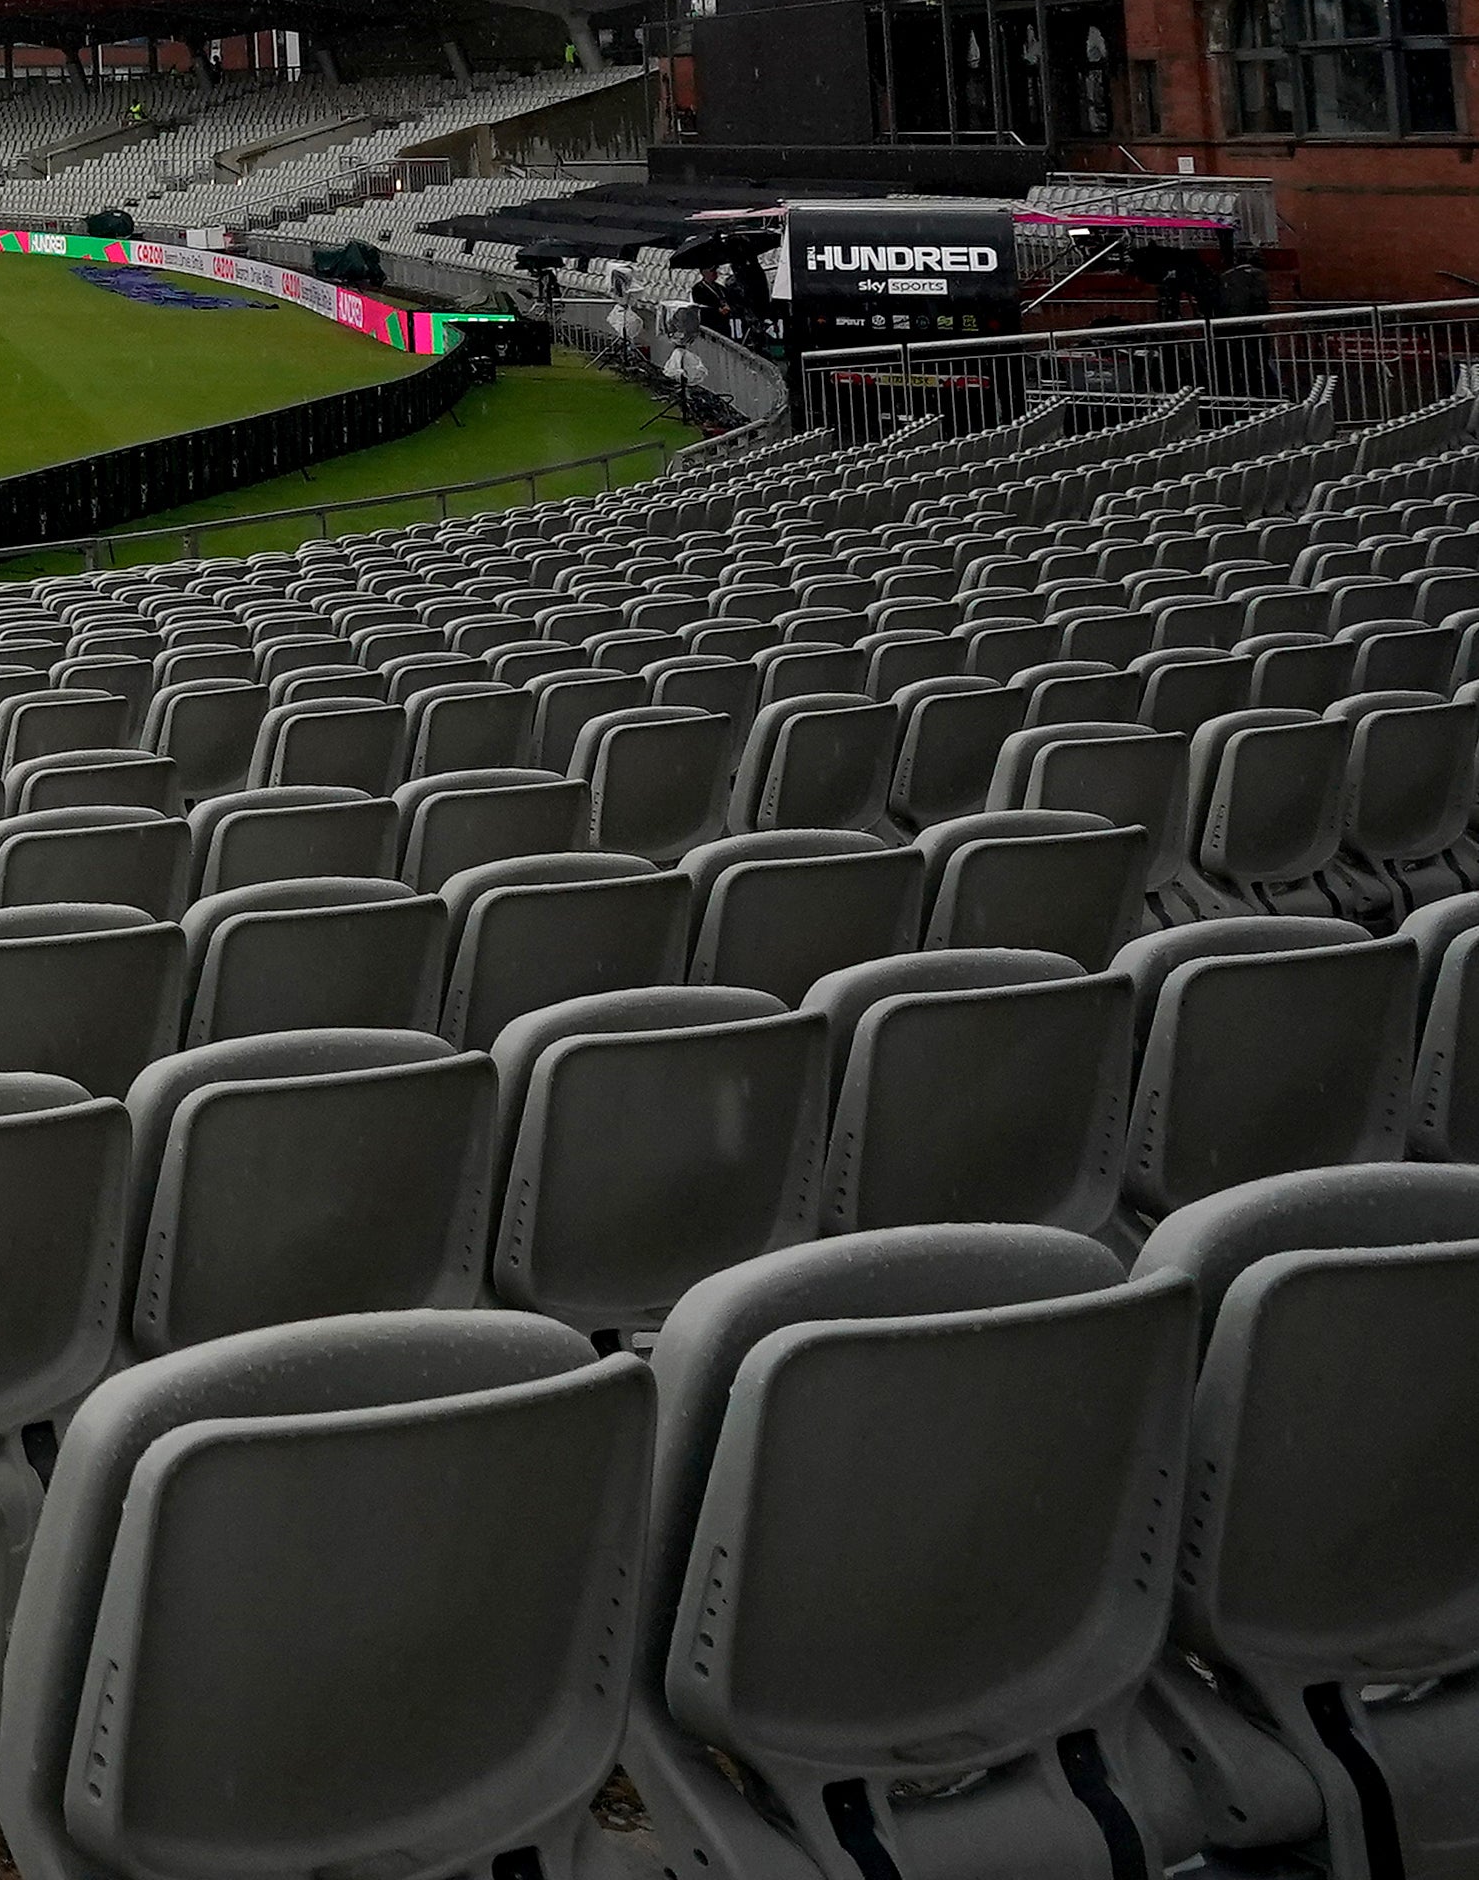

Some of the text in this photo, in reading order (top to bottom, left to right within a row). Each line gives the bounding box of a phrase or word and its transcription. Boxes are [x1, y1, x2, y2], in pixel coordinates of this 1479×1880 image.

[31, 233, 66, 254] HUNDRED
[137, 244, 164, 265] CAZOO
[812, 246, 998, 272] HUNDRED
[858, 279, 945, 294] sky sports
